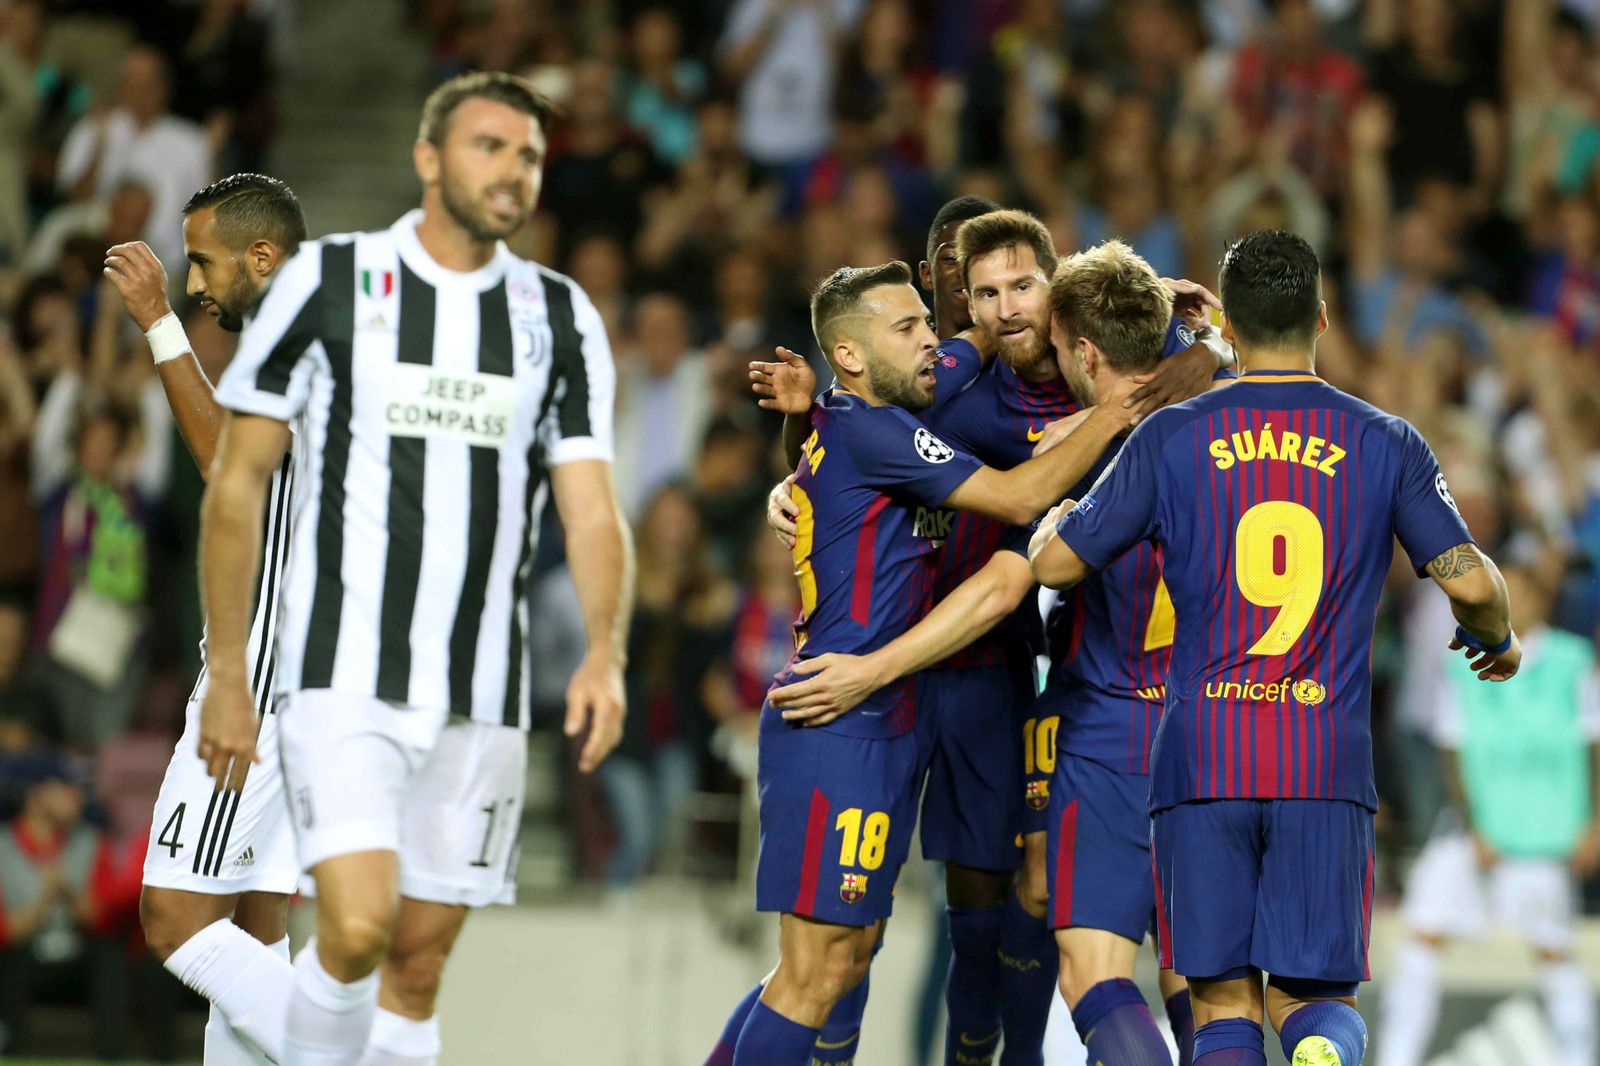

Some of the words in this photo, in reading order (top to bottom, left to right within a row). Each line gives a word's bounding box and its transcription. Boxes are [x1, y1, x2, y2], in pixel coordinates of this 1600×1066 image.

[422, 377, 486, 402] JEEP
[386, 402, 508, 437] COMPASS
[803, 428, 826, 476] BA
[1209, 423, 1347, 477] SUÁREZ
[1235, 500, 1324, 656] 9
[1205, 677, 1292, 703] unicef
[1023, 715, 1060, 774] 10
[157, 802, 187, 858] 4
[835, 807, 890, 870] 18
